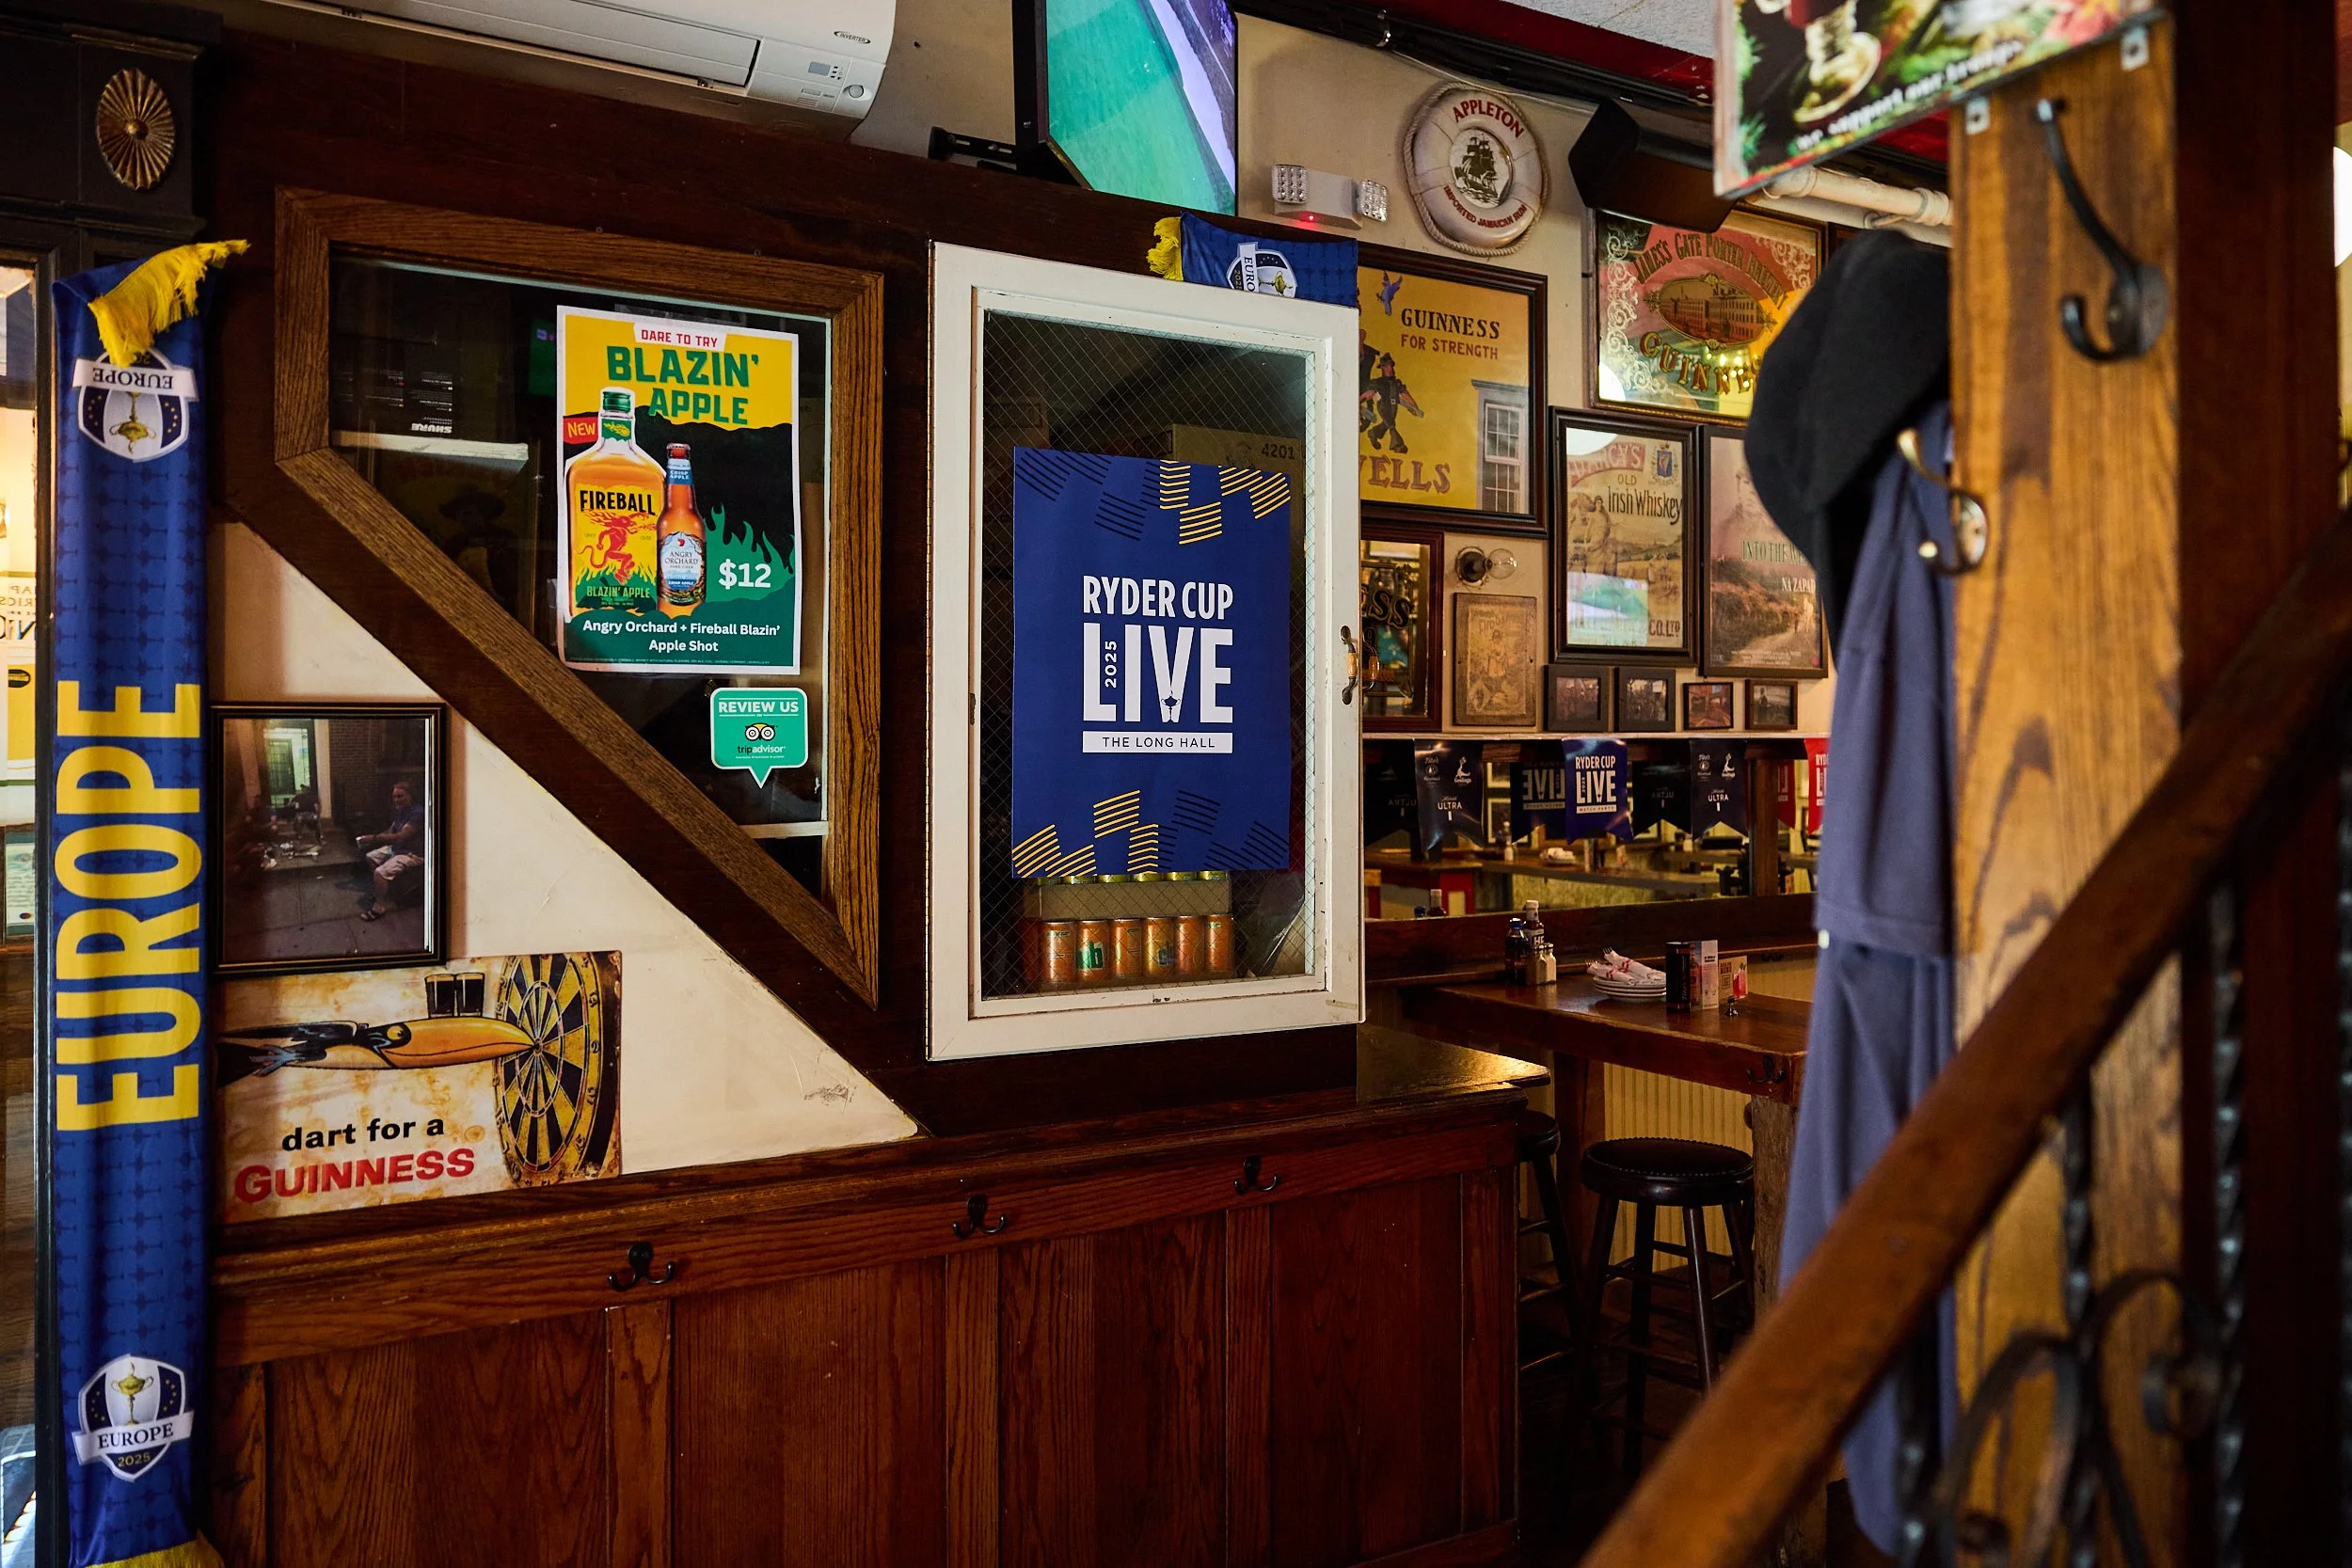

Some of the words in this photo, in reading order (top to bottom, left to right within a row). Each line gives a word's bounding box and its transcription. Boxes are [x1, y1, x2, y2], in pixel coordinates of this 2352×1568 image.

[839, 33, 866, 42] INVERTER
[1453, 100, 1524, 138] APPLETON
[1444, 186, 1476, 223] IMPORTED
[1478, 215, 1515, 229] JAMAICAN
[1514, 204, 1529, 221] RUM
[1244, 256, 1255, 293] EURO
[1675, 232, 1702, 260] GATE
[1706, 233, 1744, 269] PORTER
[1746, 252, 1787, 309] BREWERY
[1401, 309, 1500, 340] GUINNESS
[642, 330, 672, 342] DARE
[676, 334, 691, 344] TO
[696, 336, 718, 347] TRY
[1401, 334, 1426, 350] FOR
[1433, 338, 1498, 360] STRENGTH
[93, 368, 173, 389] EUROPE
[607, 346, 759, 387] BLAZIN'
[647, 388, 748, 424] APPLE
[411, 423, 452, 433] SHURE
[568, 422, 596, 438] NEW
[1261, 443, 1295, 459] 4201
[1618, 474, 1637, 486] OLD
[580, 490, 657, 515] FIREBALL
[1608, 486, 1633, 515] Irish
[1634, 489, 1682, 525] Whiskey
[1743, 541, 1767, 562] INTO
[719, 559, 771, 590] $12
[587, 587, 620, 597] BLAZIN'
[623, 588, 649, 598] APPLE
[1084, 576, 1175, 617] RYDER
[1183, 582, 1233, 620] CUP
[583, 620, 622, 635] Angry
[626, 621, 676, 633] Orchard
[691, 623, 737, 635] Fireball
[740, 625, 780, 636] Blazin'
[649, 640, 686, 653] Apple
[690, 641, 718, 652] Shot
[1084, 623, 1233, 722] LIVE
[1104, 641, 1117, 688] 2025
[719, 702, 775, 713] REVIEW
[780, 702, 798, 712] US
[738, 745, 783, 755] tripadvisor
[1103, 737, 1129, 748] THE
[1136, 737, 1173, 748] LONG
[1181, 738, 1215, 748] HALL
[1576, 756, 1599, 769] RYDER
[1601, 755, 1615, 768] CUP
[1576, 770, 1616, 803] LIVE
[56, 680, 201, 1130] EUROPE
[282, 1127, 356, 1151] dart
[367, 1118, 416, 1141] for
[427, 1119, 444, 1136] a
[235, 1148, 475, 1203] GUINNESS
[99, 1423, 173, 1449] EUROPE
[119, 1452, 151, 1467] 2025
